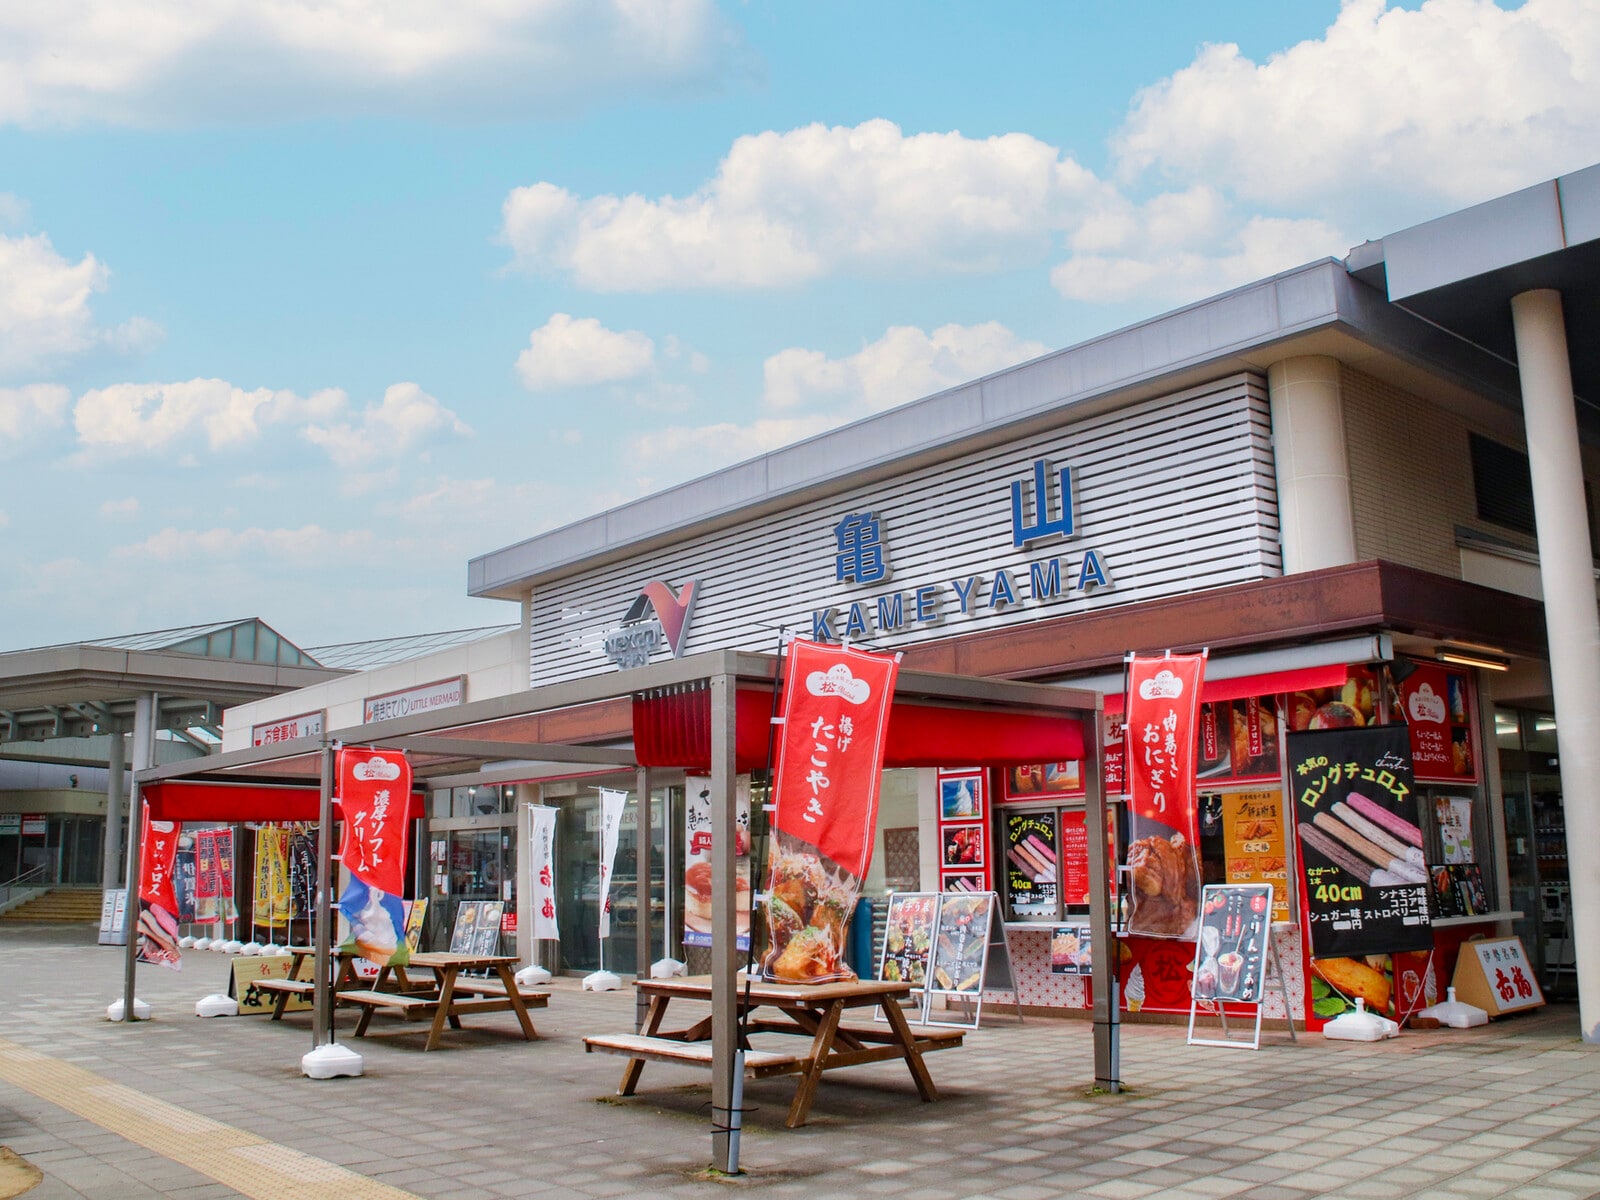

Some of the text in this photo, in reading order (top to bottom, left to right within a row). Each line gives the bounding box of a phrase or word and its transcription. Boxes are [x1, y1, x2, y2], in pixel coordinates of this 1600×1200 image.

[813, 550, 1111, 643] KAMEYAMA
[819, 681, 837, 694] 松
[1149, 686, 1162, 697] 松
[373, 691, 460, 721] 焼きたてパン LITTLE MERMAID
[263, 722, 298, 745] お食事処
[836, 713, 855, 753] 揚げ
[1162, 708, 1179, 778] 肉巻き
[802, 715, 836, 824] たこやき
[1142, 723, 1166, 813] おにぎり
[1296, 756, 1329, 776] 本気の
[1301, 762, 1410, 808] ロングチュロス
[369, 789, 391, 867] 濃厚ソフト
[1010, 819, 1054, 842] ロングチュロス
[353, 811, 370, 872] クリーム
[1307, 867, 1339, 876] ながーい
[1310, 877, 1322, 885] 1本
[1315, 884, 1363, 903] 40cm
[1380, 887, 1427, 900] シナモン味
[1390, 897, 1428, 908] ココア味
[1310, 908, 1362, 922] シュガー味
[1364, 906, 1429, 920] ストロベリー味
[1420, 915, 1430, 925] 円
[1352, 920, 1362, 930] 円
[260, 962, 292, 976] 名物
[1152, 955, 1184, 982] 松
[1243, 921, 1260, 999] りんごあめ
